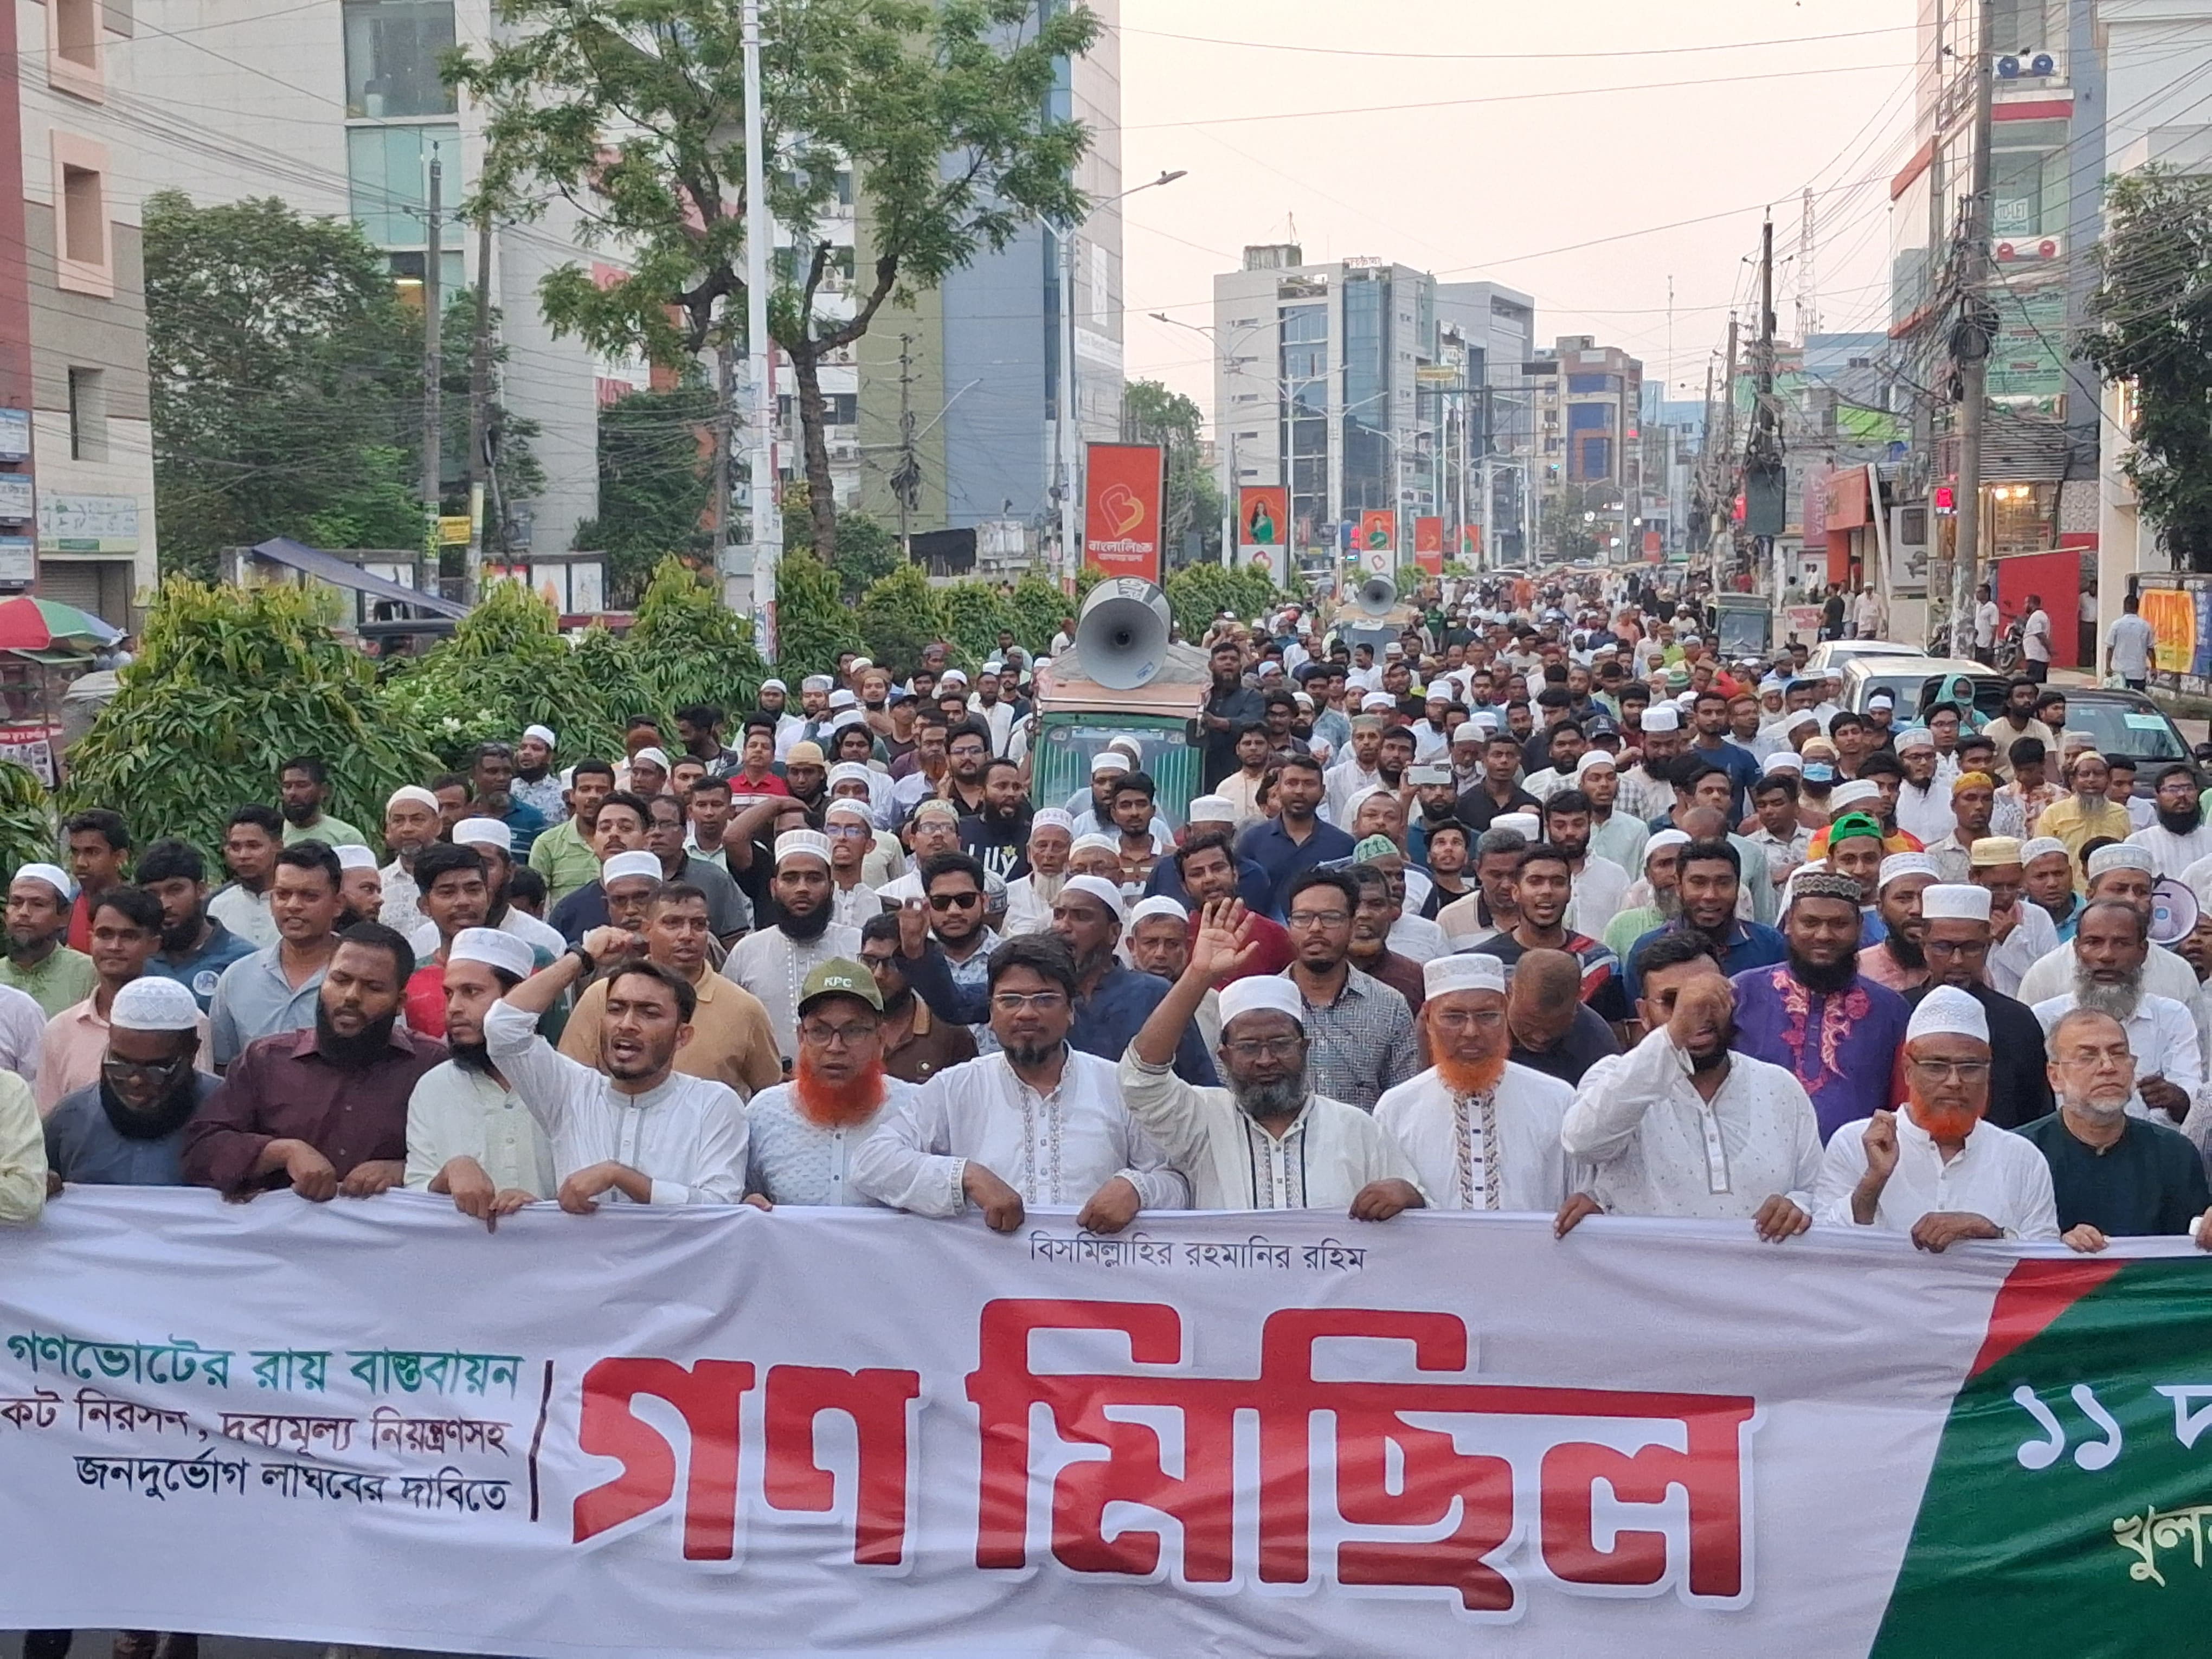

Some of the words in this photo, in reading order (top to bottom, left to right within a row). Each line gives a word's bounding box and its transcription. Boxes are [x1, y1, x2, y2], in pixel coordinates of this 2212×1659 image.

[1030, 1230, 1175, 1268] বিসমিল্লাহির
[1184, 1235, 1293, 1270] রহমানির
[1301, 1238, 1367, 1270] রহিম
[8, 1330, 234, 1390] গণভোটের
[249, 1348, 332, 1392] রায়
[345, 1348, 525, 1397] বাস্তবায়ন
[0, 1385, 63, 1430] কট
[2012, 1384, 2123, 1470] ১১
[75, 1446, 249, 1501] জনদুর্ভোগ
[260, 1461, 388, 1504] লাঘবের
[401, 1465, 511, 1513] দাবিতে
[573, 1358, 920, 1564] গণ
[965, 1298, 1754, 1610] মিছিল
[2113, 1504, 2212, 1587] খুল
